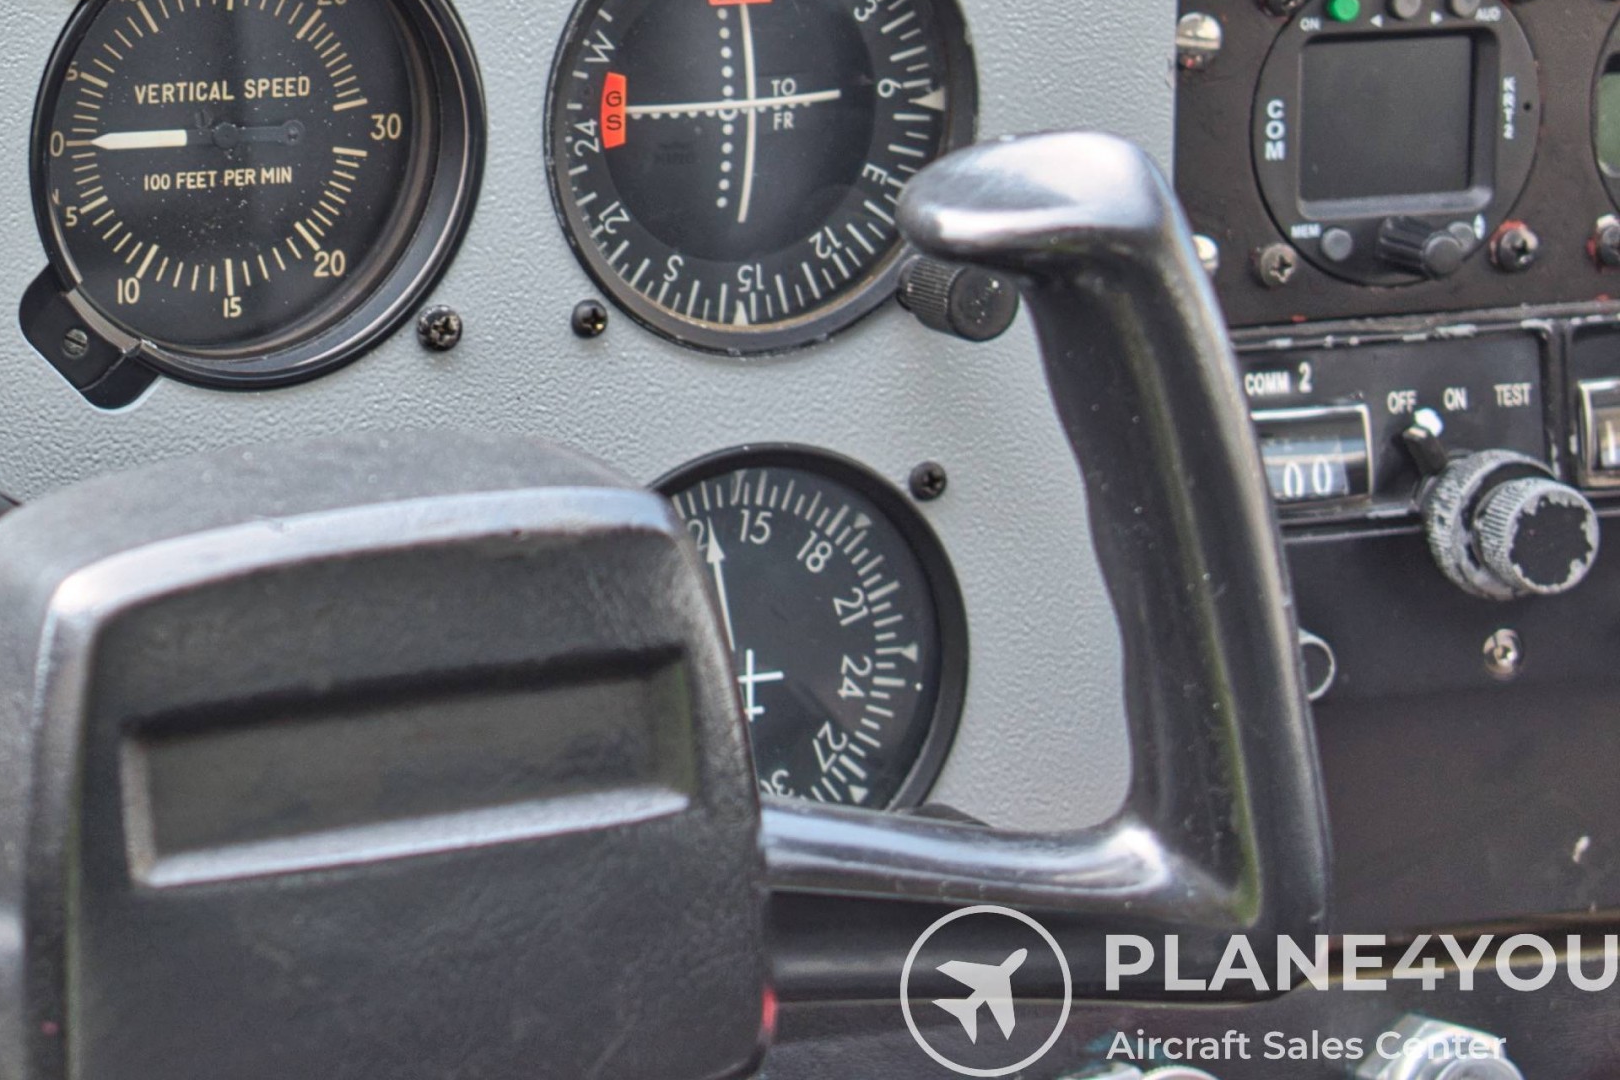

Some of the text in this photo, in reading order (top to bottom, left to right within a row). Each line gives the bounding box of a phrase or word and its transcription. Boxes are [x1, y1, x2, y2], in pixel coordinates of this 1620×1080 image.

[1300, 17, 1320, 31] ON
[587, 31, 616, 64] W
[134, 76, 310, 104] VERTICAL SPEED
[771, 78, 796, 95] TO
[878, 78, 903, 98] 6
[371, 114, 402, 139] 30
[773, 112, 795, 129] FR
[50, 132, 64, 156] 0
[574, 118, 601, 156] 24
[144, 167, 292, 190] 100 FEET PER MIN
[861, 163, 889, 185] E
[66, 209, 78, 227] 5
[598, 201, 630, 235] 21
[808, 227, 842, 260] 12
[1291, 224, 1320, 238] MEM
[315, 250, 346, 277] 20
[663, 255, 683, 281] S
[737, 263, 764, 293] 15
[118, 279, 140, 304] 10
[224, 298, 242, 318] 15
[1245, 362, 1312, 396] COMM 2
[1387, 392, 1417, 412] OFF
[1444, 388, 1467, 410] ON
[1495, 383, 1531, 406] TEST
[739, 510, 772, 544] 15
[797, 531, 833, 573] 18
[833, 587, 870, 626] 21
[838, 654, 872, 699] 24
[813, 721, 848, 772] 27
